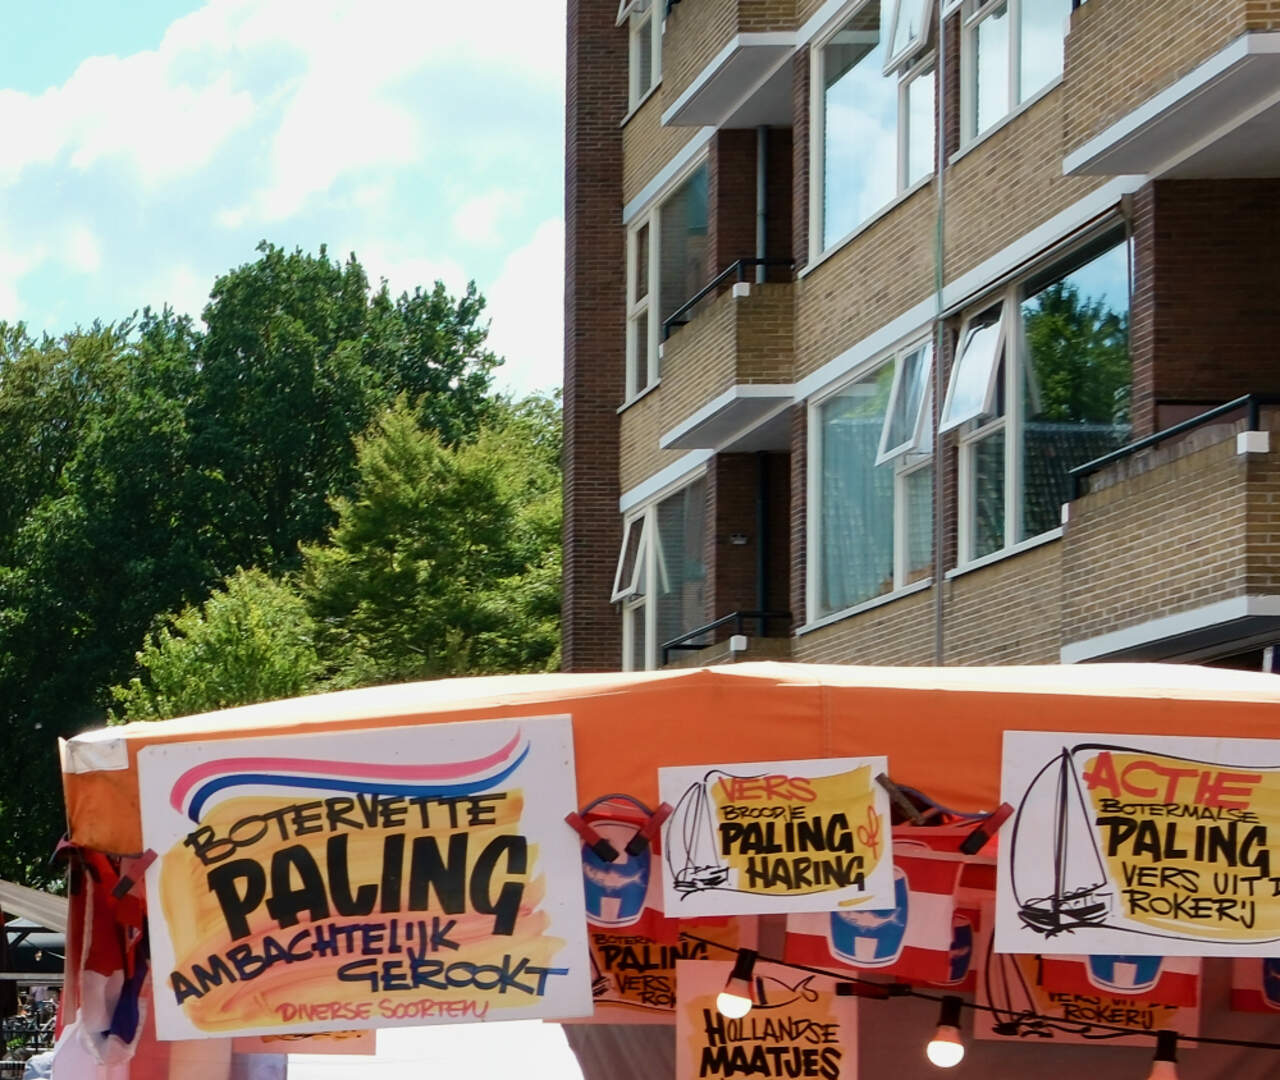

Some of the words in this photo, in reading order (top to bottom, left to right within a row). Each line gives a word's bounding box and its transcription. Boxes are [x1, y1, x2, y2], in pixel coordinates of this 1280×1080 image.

[718, 775, 817, 802] VERS
[1082, 751, 1262, 810] ACTIE
[184, 792, 508, 867] BOTERVETTE
[1097, 798, 1260, 825] BOTERMALSE
[718, 813, 855, 856] PALING
[1095, 817, 1271, 879] PALING
[207, 832, 528, 942] PALING
[745, 856, 865, 892] HARING
[1121, 861, 1200, 894] VERS
[1213, 871, 1264, 897] UIT
[169, 916, 460, 1007] AMBACHTELIJK
[337, 955, 570, 996] GEROOKT
[614, 973, 671, 994] VERS
[274, 1001, 372, 1023] DIVERSE
[377, 998, 489, 1019] SOORTEN
[702, 1008, 841, 1047] HOLLANDSE
